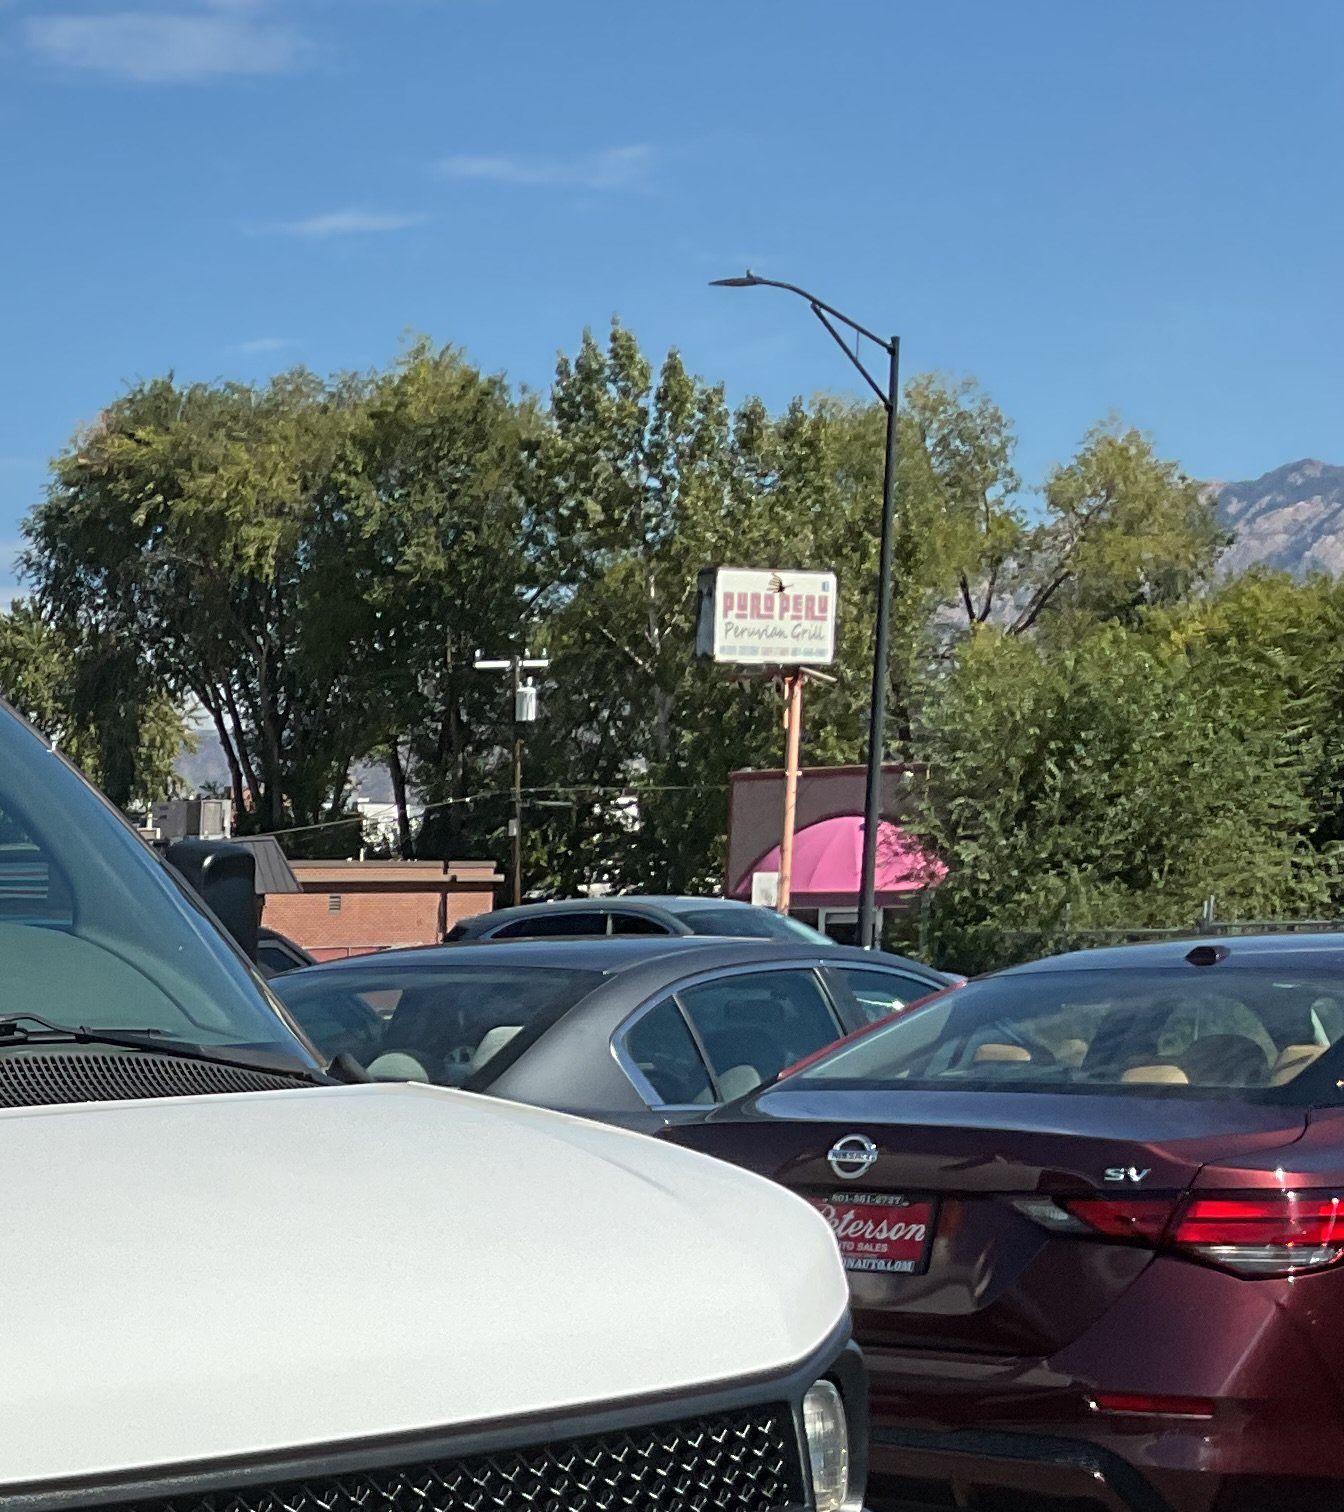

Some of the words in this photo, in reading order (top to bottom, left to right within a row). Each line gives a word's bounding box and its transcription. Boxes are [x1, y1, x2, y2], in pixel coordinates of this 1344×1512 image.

[723, 591, 774, 620] PURO
[779, 593, 829, 621] PERU
[725, 621, 788, 640] Peruvian
[791, 623, 825, 640] Grill
[1104, 1167, 1152, 1182] SV
[856, 1242, 889, 1253] SALES
